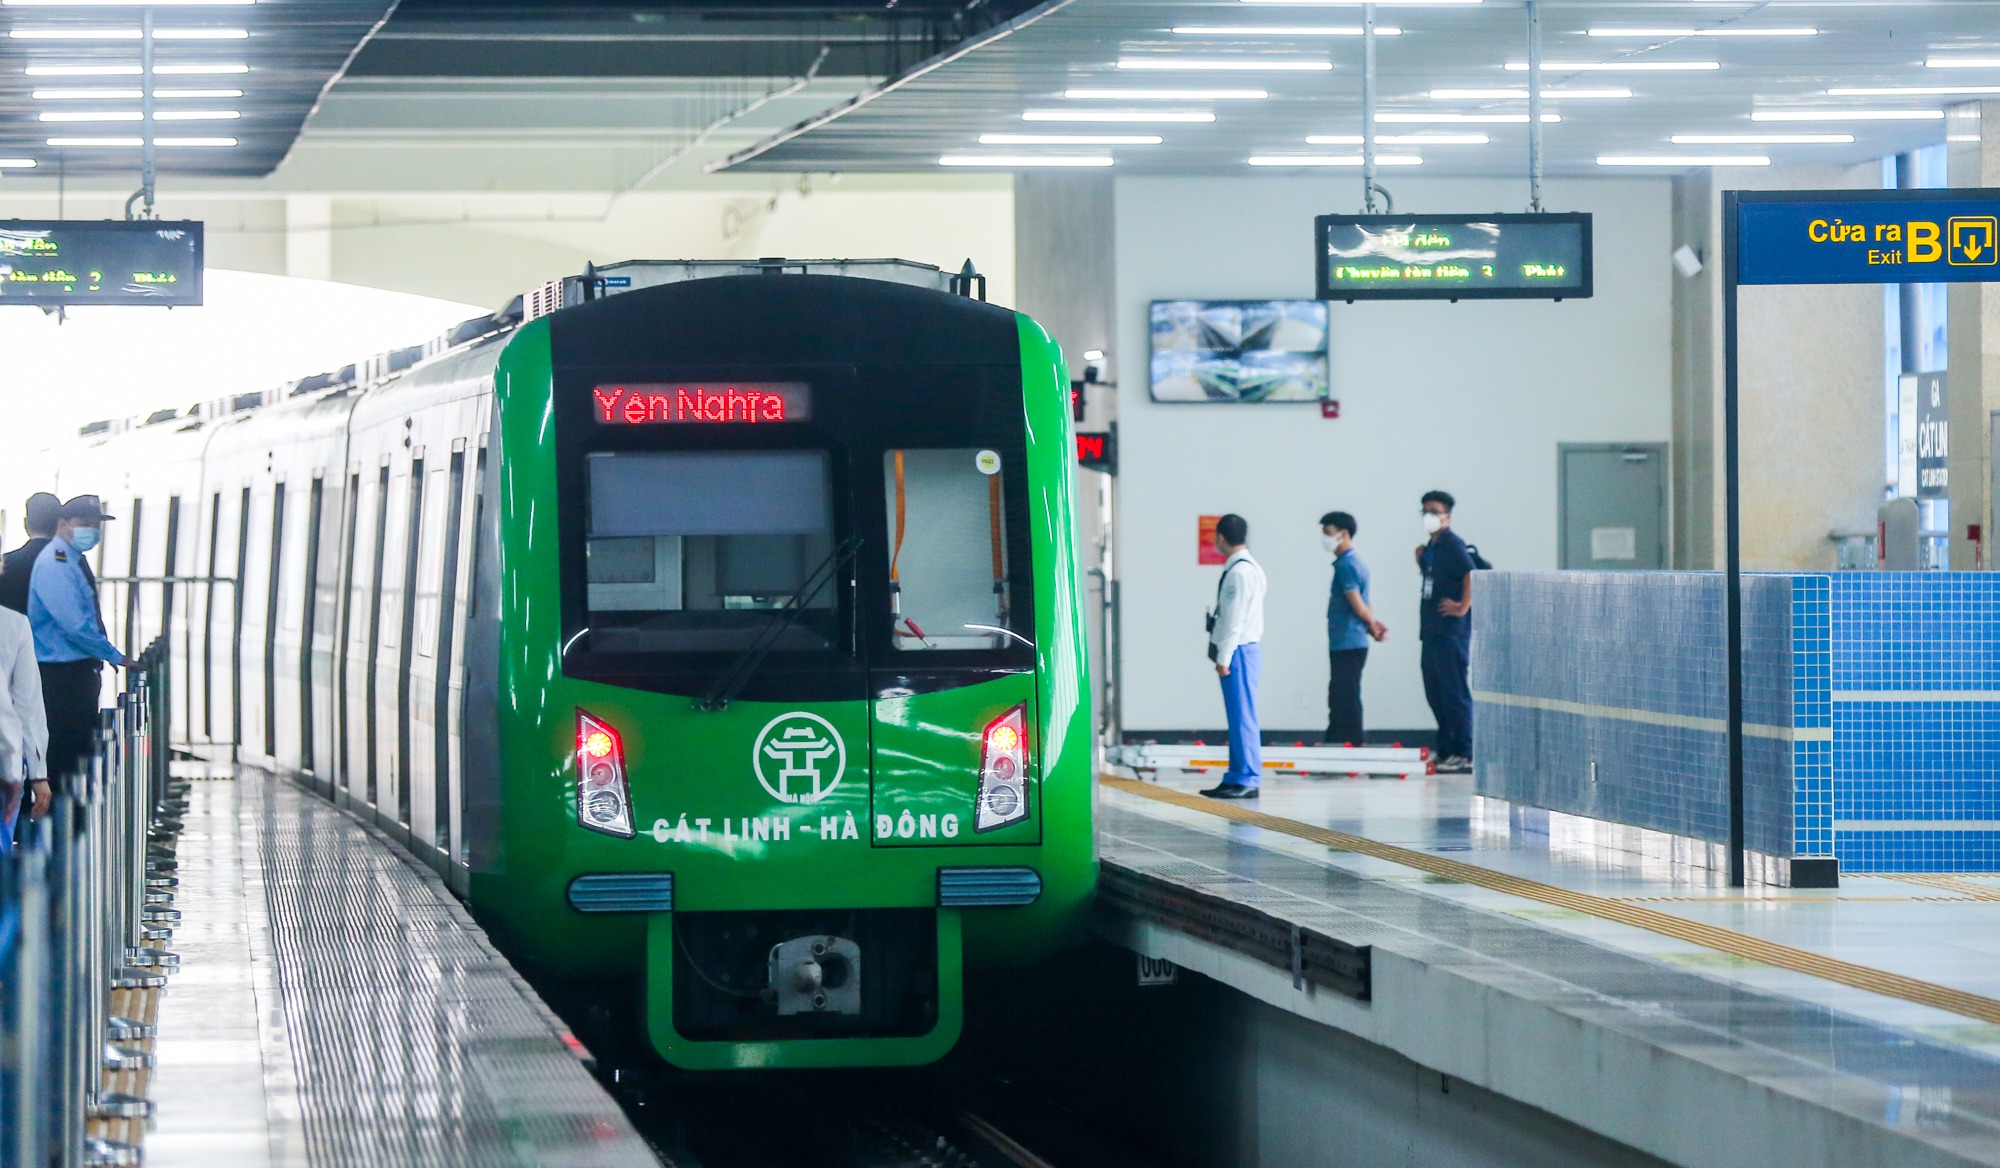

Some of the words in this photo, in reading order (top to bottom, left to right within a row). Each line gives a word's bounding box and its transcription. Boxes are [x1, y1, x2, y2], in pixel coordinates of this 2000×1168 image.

[1808, 218, 1866, 243] Cửa
[1875, 224, 1902, 242] ra
[1907, 221, 1943, 263] B
[1868, 249, 1902, 265] Exit
[593, 387, 670, 425] Yên
[677, 387, 785, 424] Nghĩa
[1935, 420, 1949, 458] LIN
[652, 812, 712, 843] CÁT
[723, 816, 791, 842] LINH
[820, 810, 859, 840] HÀ
[876, 808, 959, 839] ĐÔNG
